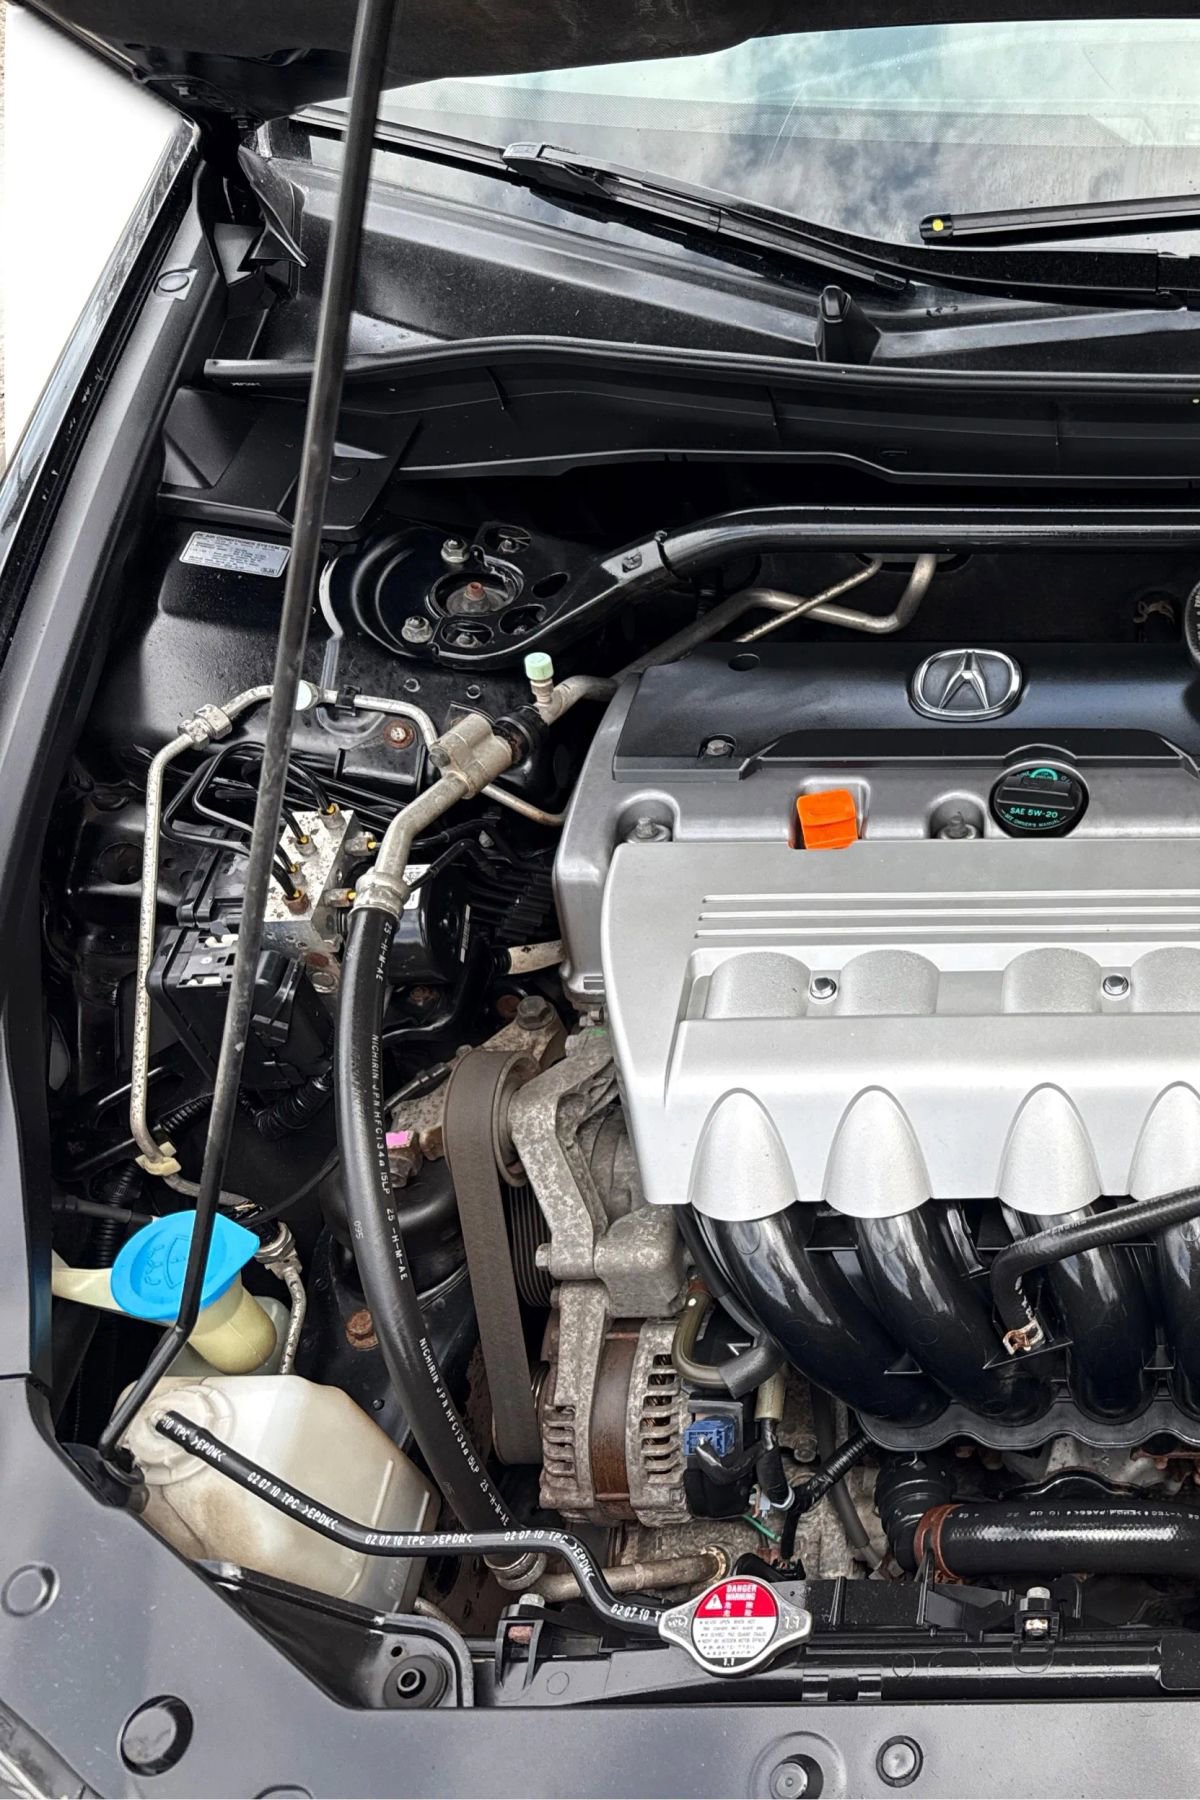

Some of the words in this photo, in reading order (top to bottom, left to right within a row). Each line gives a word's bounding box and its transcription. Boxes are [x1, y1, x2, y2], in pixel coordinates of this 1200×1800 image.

[1010, 807, 1026, 815] SAE
[1027, 808, 1058, 818] 5W-20
[371, 1034, 380, 1080] NICHIRIN
[419, 1337, 439, 1384] NICHIRIN
[281, 1492, 300, 1510] TPC
[407, 1535, 426, 1546] TPC
[548, 1530, 569, 1544] TPC
[726, 1584, 757, 1593] DANGER
